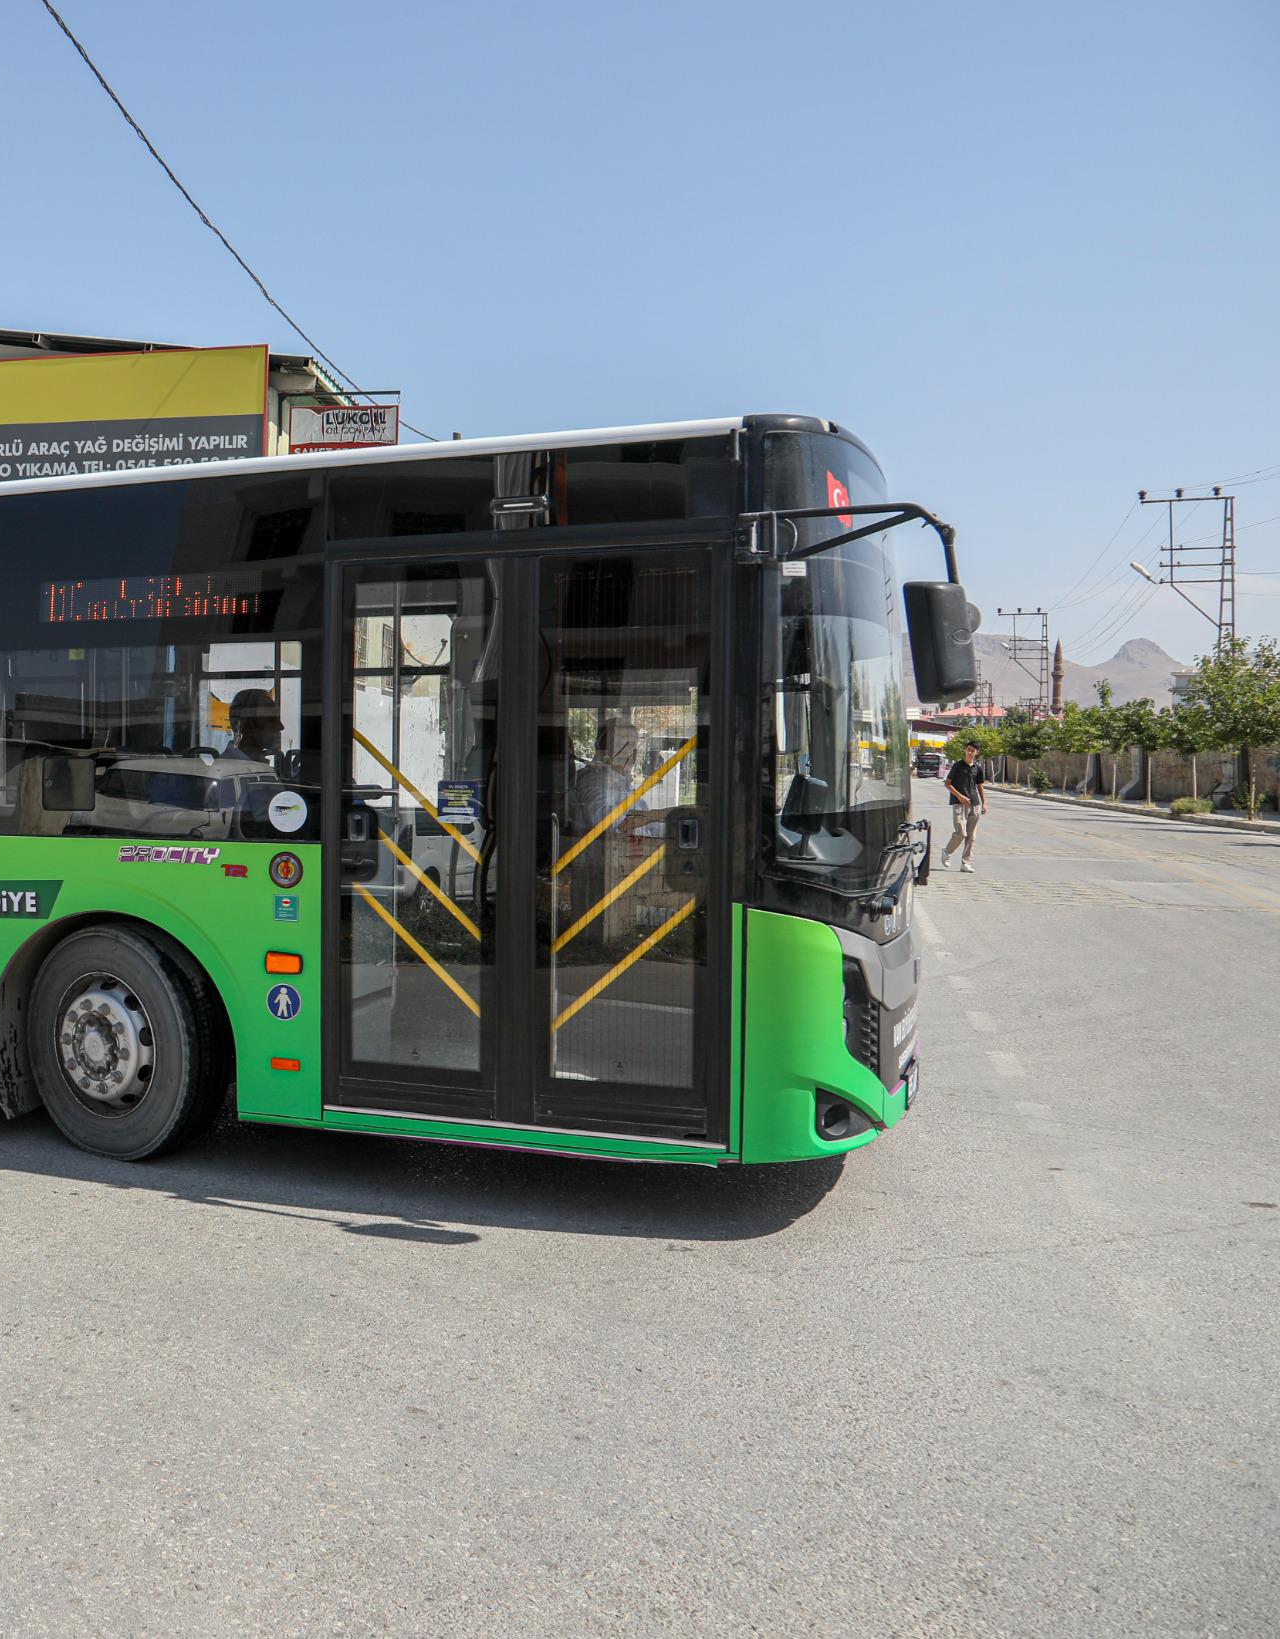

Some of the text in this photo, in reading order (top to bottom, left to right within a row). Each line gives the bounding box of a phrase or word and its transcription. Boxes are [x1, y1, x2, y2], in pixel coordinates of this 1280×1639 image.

[325, 412, 387, 425] LUKOIL
[27, 441, 70, 460] ARAÇ
[74, 436, 108, 454] YAĞ
[112, 434, 183, 455] DEĞİŞİMİ
[187, 434, 248, 449] YAPILIR
[15, 460, 78, 477] YIKAMA
